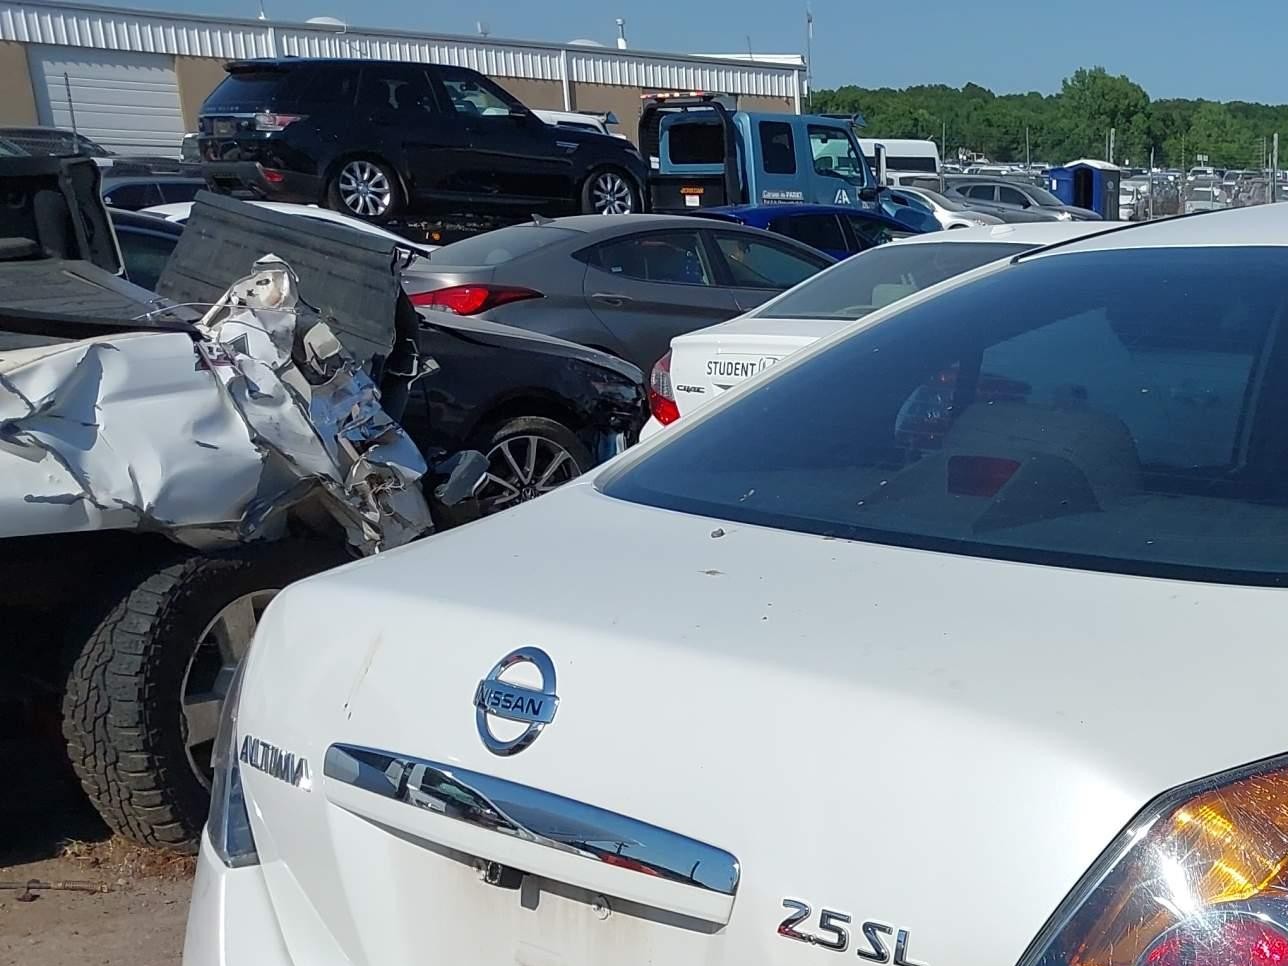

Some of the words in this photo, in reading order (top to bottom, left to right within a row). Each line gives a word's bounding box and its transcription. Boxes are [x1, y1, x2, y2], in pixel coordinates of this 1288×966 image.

[706, 360, 756, 377] STUDENT
[676, 384, 705, 393] CIVIC
[477, 687, 544, 716] NISSAN
[239, 734, 312, 792] ALTIMA
